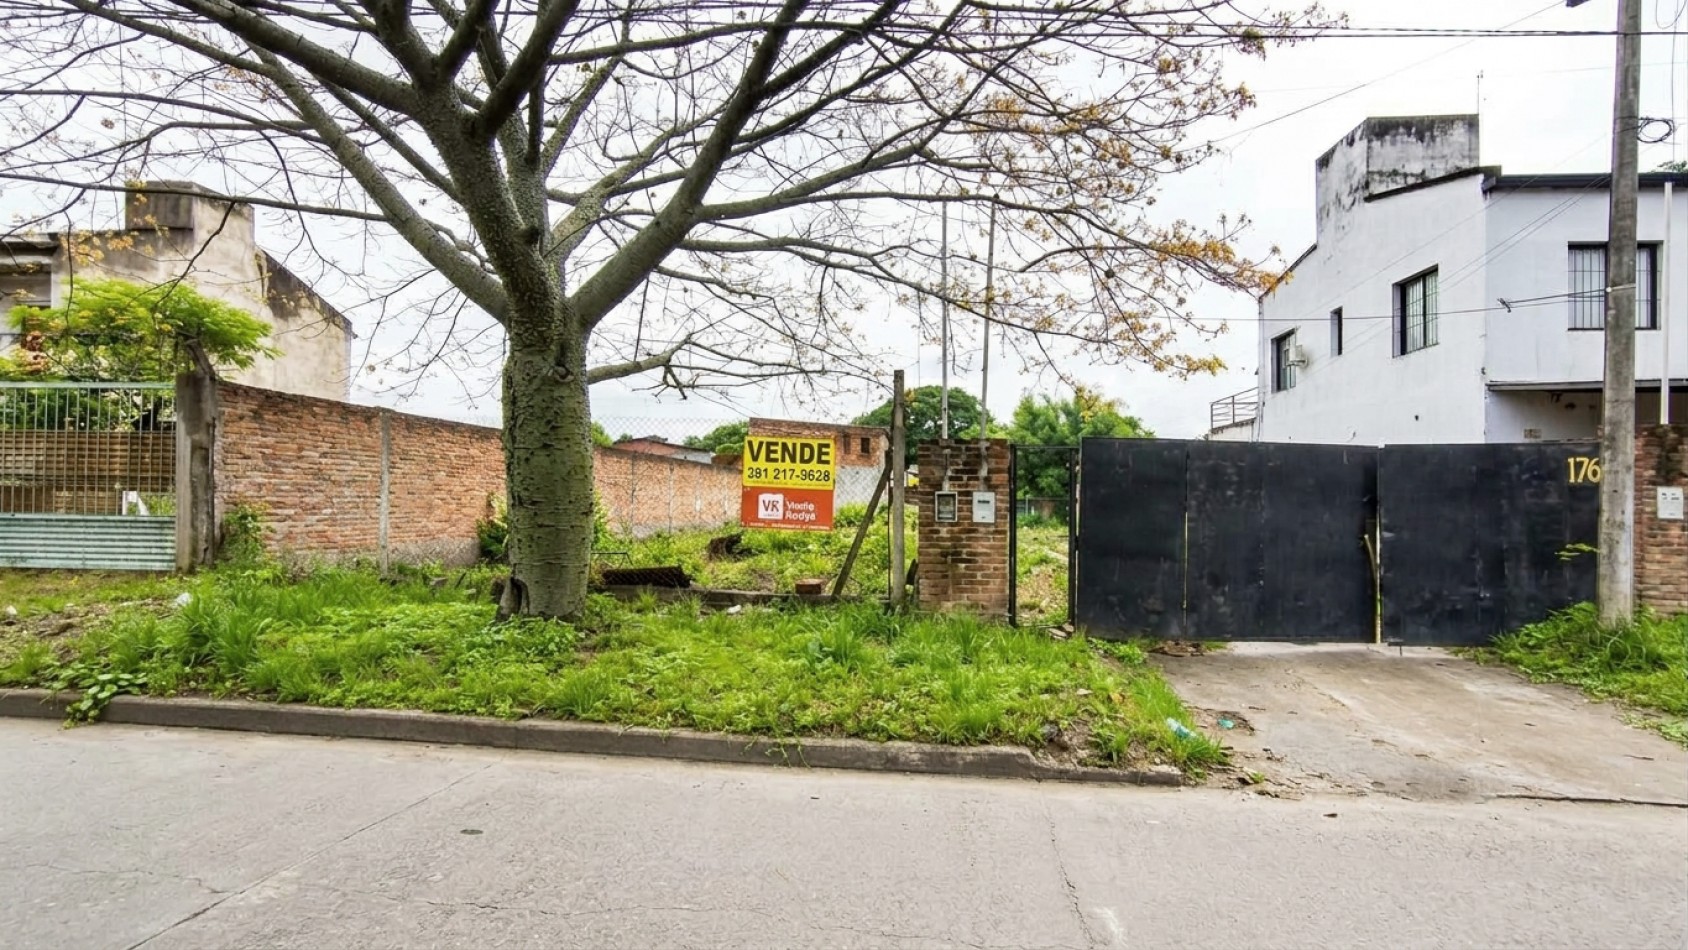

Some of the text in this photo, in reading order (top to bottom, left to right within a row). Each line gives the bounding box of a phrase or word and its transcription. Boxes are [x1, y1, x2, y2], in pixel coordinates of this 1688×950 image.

[747, 440, 831, 465] VENDE
[747, 467, 831, 482] 381 217-9628
[1567, 456, 1601, 483] 176
[762, 499, 780, 512] VR
